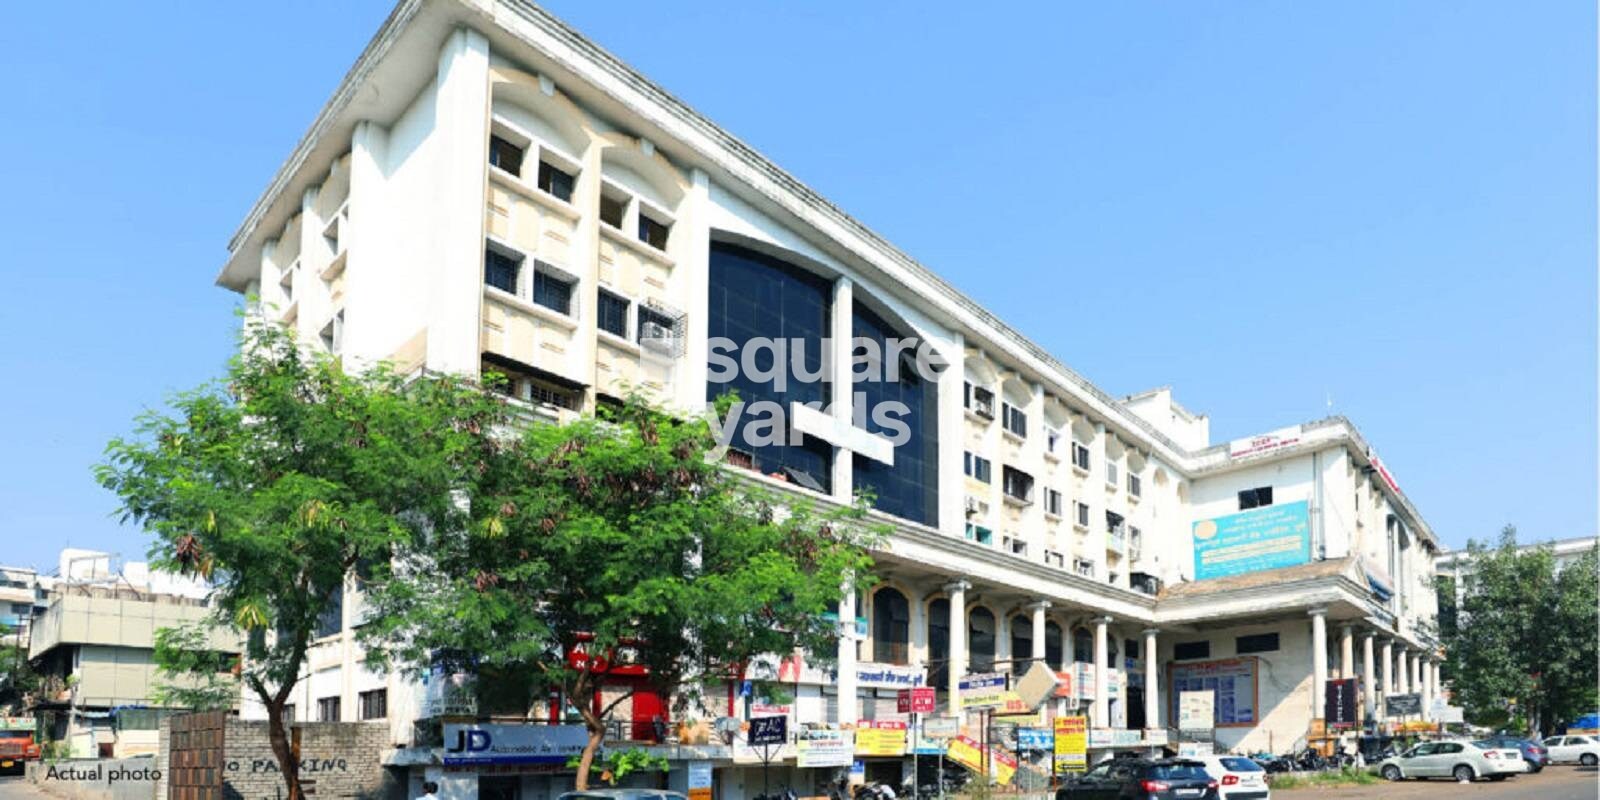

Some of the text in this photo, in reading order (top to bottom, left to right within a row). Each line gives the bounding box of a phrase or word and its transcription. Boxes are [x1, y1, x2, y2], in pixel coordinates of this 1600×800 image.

[915, 696, 932, 705] ATM
[447, 730, 492, 753] JD
[223, 760, 240, 772] O
